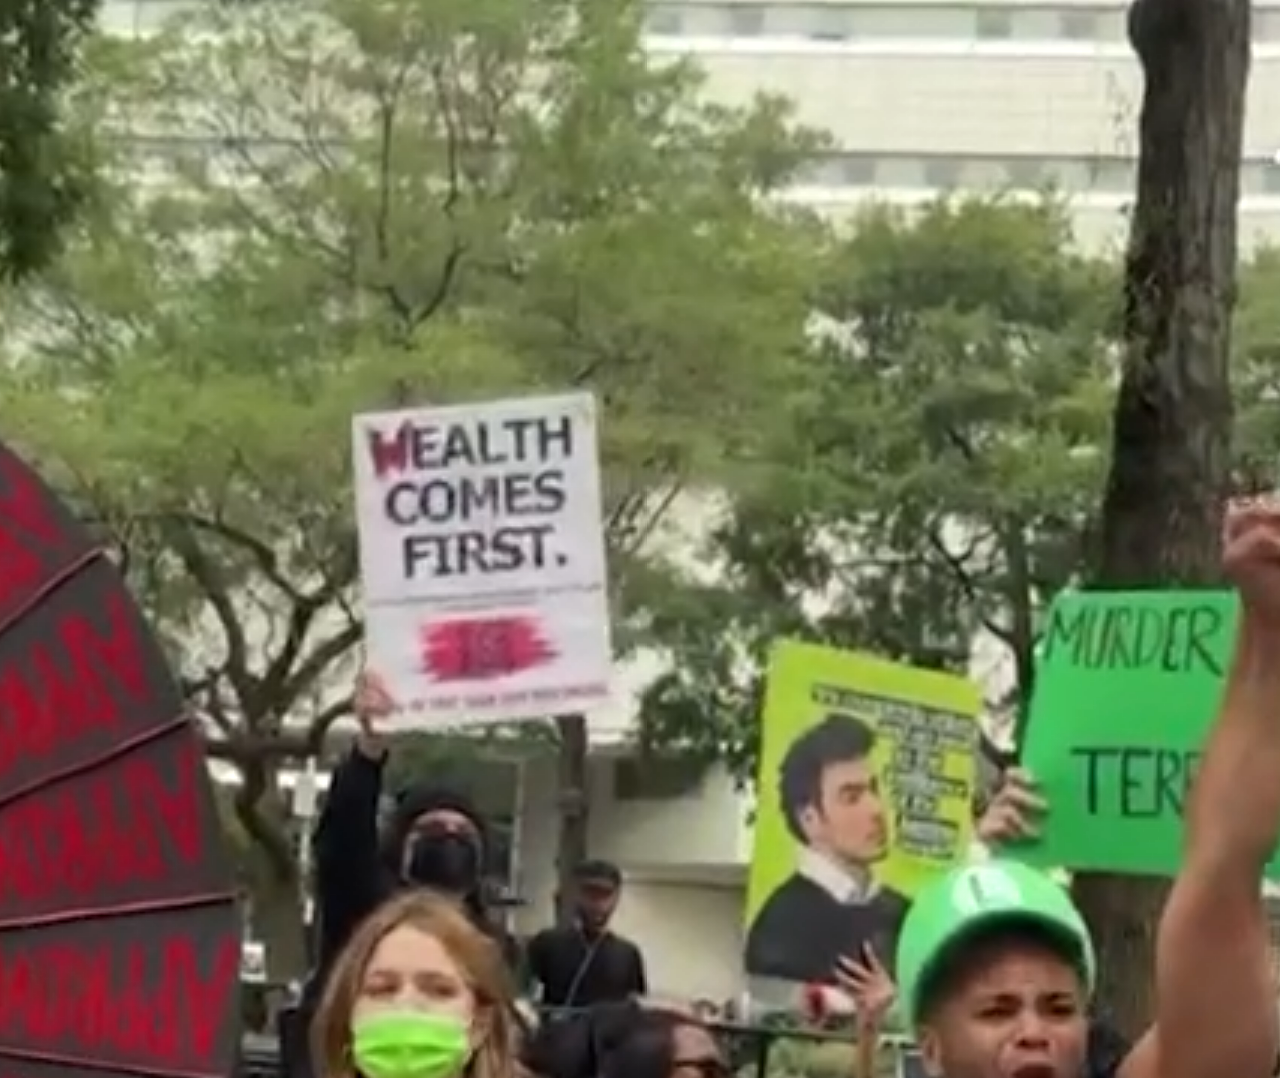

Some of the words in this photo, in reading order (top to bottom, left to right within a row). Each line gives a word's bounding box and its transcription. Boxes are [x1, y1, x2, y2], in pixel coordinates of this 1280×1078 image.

[367, 415, 572, 480] WEALTH
[385, 470, 567, 526] COMES
[403, 525, 568, 579] FIRST.
[1043, 606, 1223, 678] MURDER
